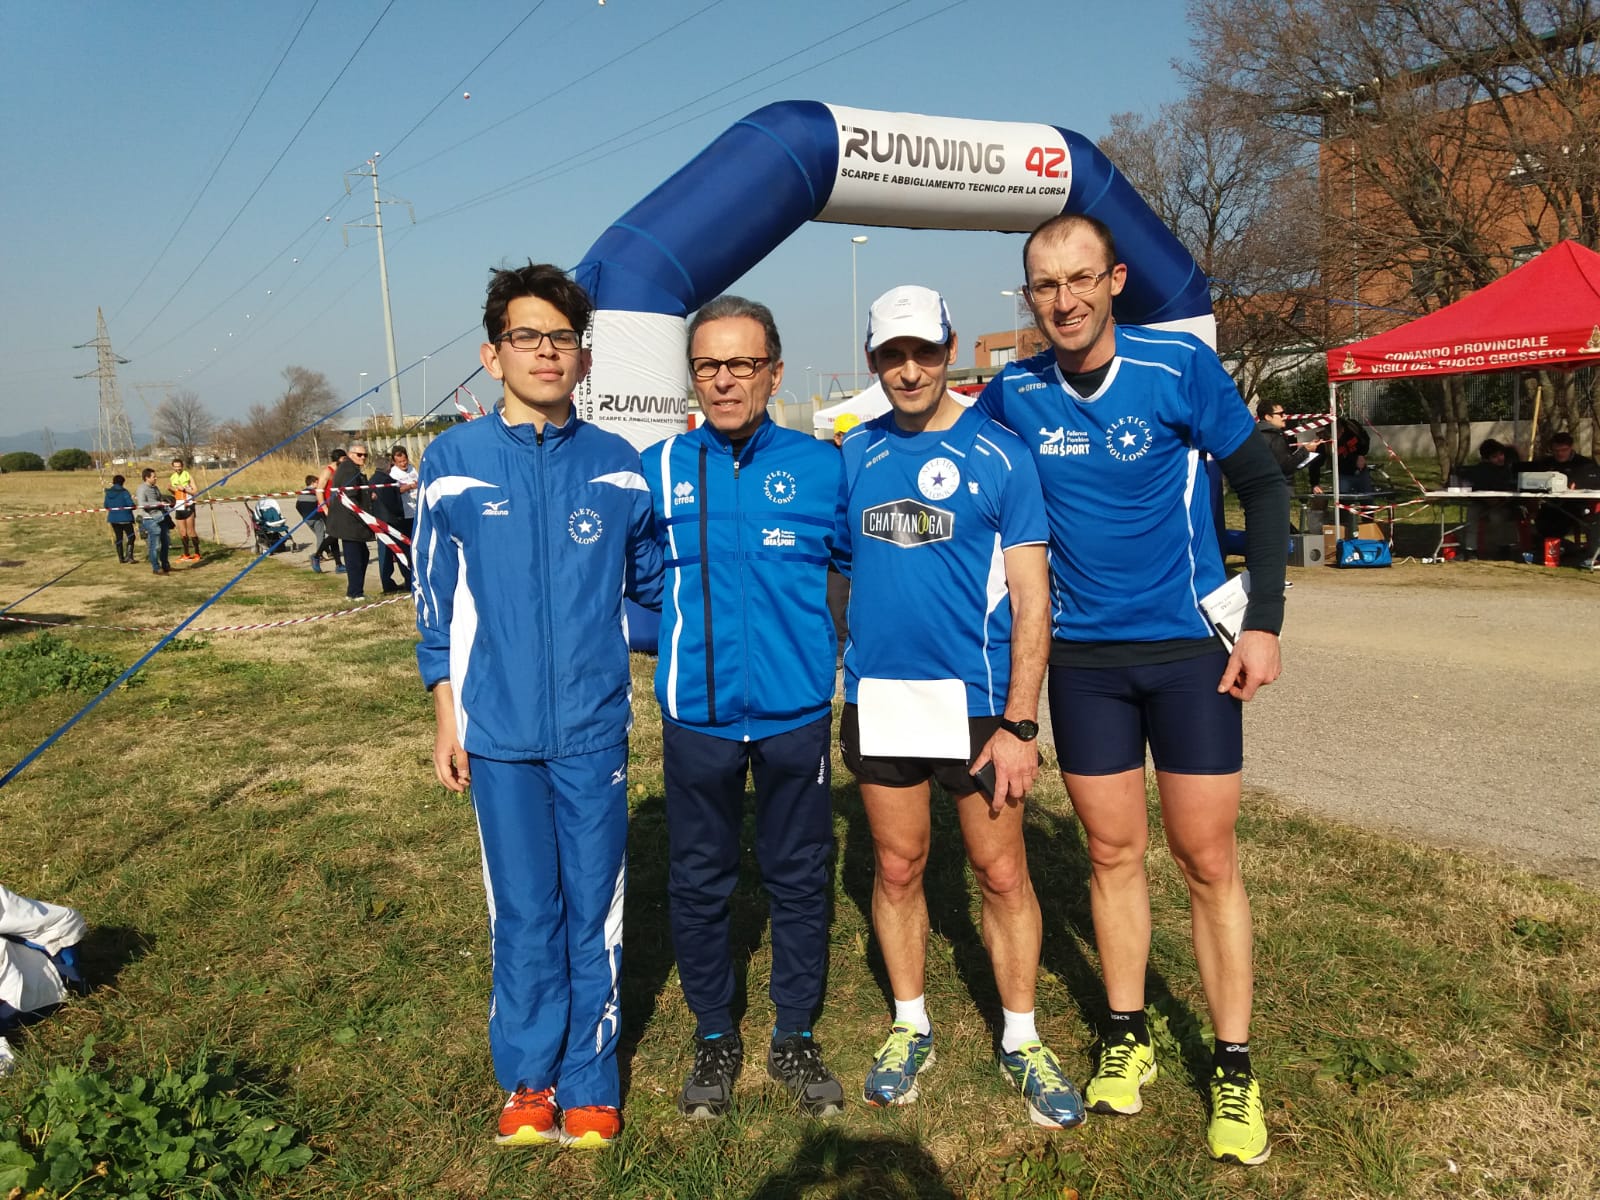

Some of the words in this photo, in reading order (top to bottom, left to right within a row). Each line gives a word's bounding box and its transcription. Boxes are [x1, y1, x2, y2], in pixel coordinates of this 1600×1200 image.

[843, 127, 1005, 175] RUNNING
[1025, 146, 1066, 178] 42
[841, 167, 880, 182] SCARPE
[882, 173, 889, 183] E
[891, 175, 966, 191] ABBIGLIAMENTO
[968, 182, 1006, 193] TECNICO
[1007, 185, 1024, 194] PER
[1026, 186, 1036, 194] LA
[1039, 186, 1066, 195] CORSA
[1384, 346, 1450, 361] COMANDO
[1453, 336, 1549, 356] PROVINCIALE
[1371, 362, 1409, 374] VIGILI
[1410, 360, 1435, 371] DEL
[1438, 356, 1485, 369] FUOCO
[1489, 348, 1566, 365] GROSSETO
[599, 394, 686, 415] RUNNING
[1105, 416, 1151, 442] ATLETICA
[764, 470, 796, 490] ATLETICA
[763, 486, 797, 505] FOLLONICA
[568, 508, 602, 526] ATLETICA
[568, 526, 603, 545] FOLLONICA
